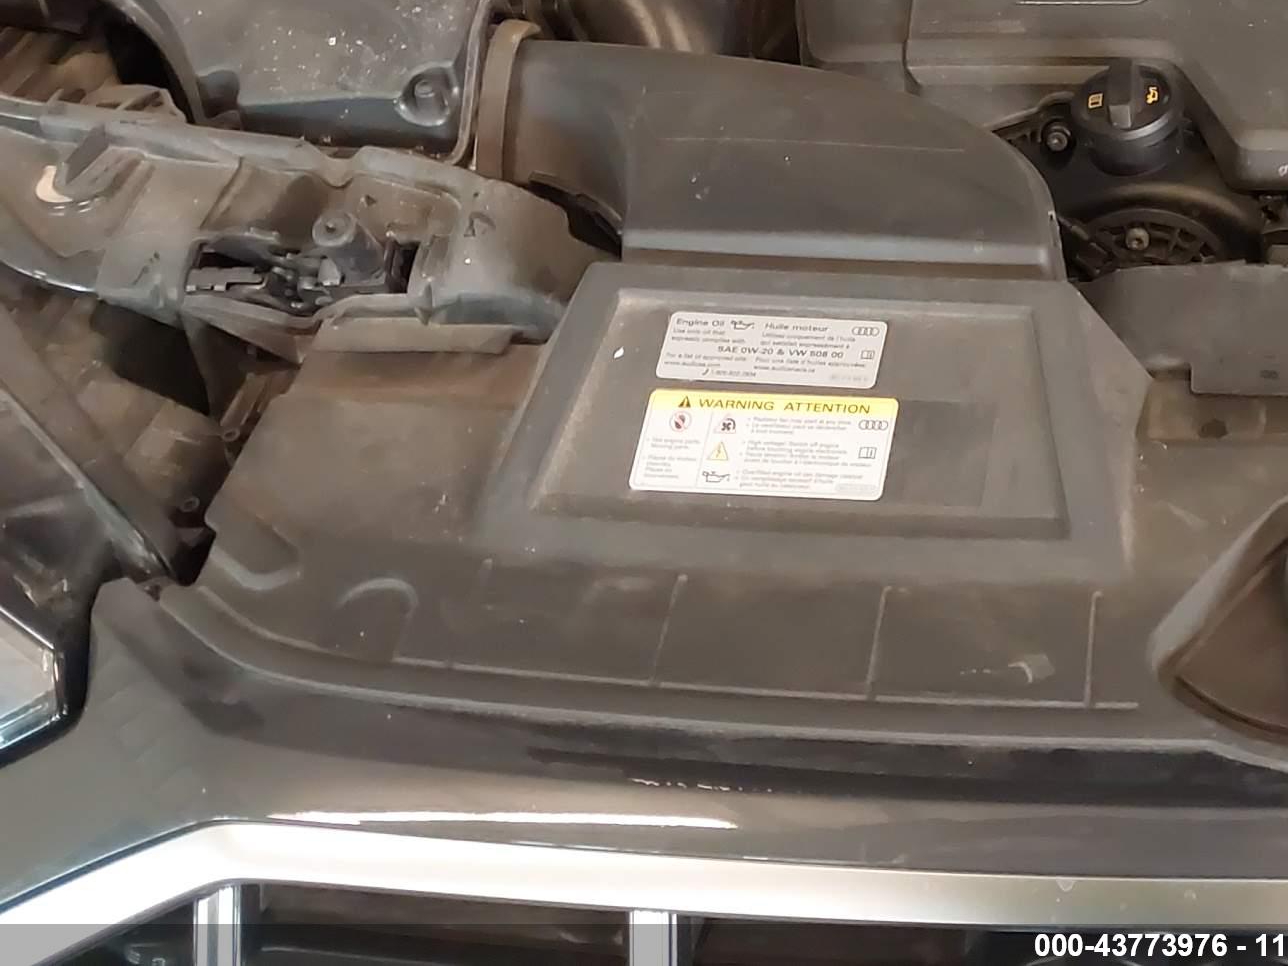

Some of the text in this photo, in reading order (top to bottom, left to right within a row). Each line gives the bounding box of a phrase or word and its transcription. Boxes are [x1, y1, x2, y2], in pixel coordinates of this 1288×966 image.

[676, 318, 725, 328] Engine Oil
[765, 323, 829, 332] Huile moteur
[717, 345, 738, 353] SAE
[776, 348, 785, 356] &
[789, 349, 808, 357] VW
[830, 351, 844, 359] 00
[699, 398, 871, 414] WARNING ATTENTION
